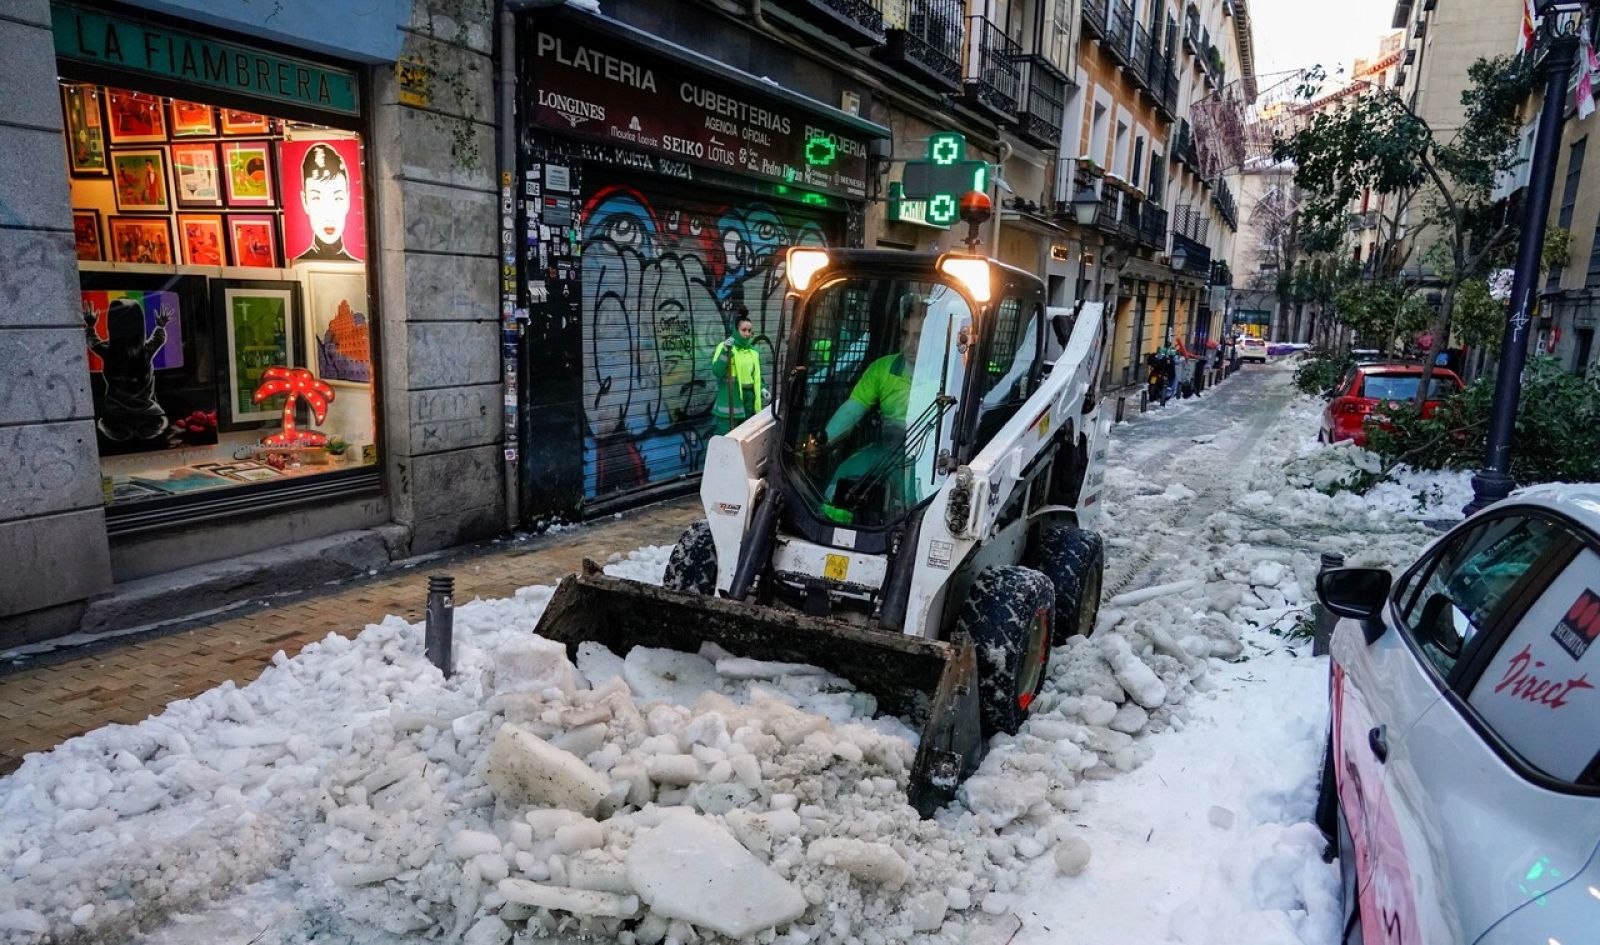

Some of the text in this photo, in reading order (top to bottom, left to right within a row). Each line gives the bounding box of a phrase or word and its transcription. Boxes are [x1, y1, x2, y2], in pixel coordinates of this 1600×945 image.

[76, 16, 125, 63] LA
[144, 32, 331, 105] FIAMBRERA
[538, 31, 657, 93] PLATERIA
[680, 82, 791, 135] CUBERTERIAS
[805, 125, 868, 160] RELOJERIA
[538, 89, 606, 121] LONGINES
[704, 115, 738, 138] AGENCIA
[663, 134, 704, 158] SEIKO
[708, 145, 735, 166] LOTUS
[761, 158, 782, 177] Pedro
[1494, 643, 1595, 709] Direct
